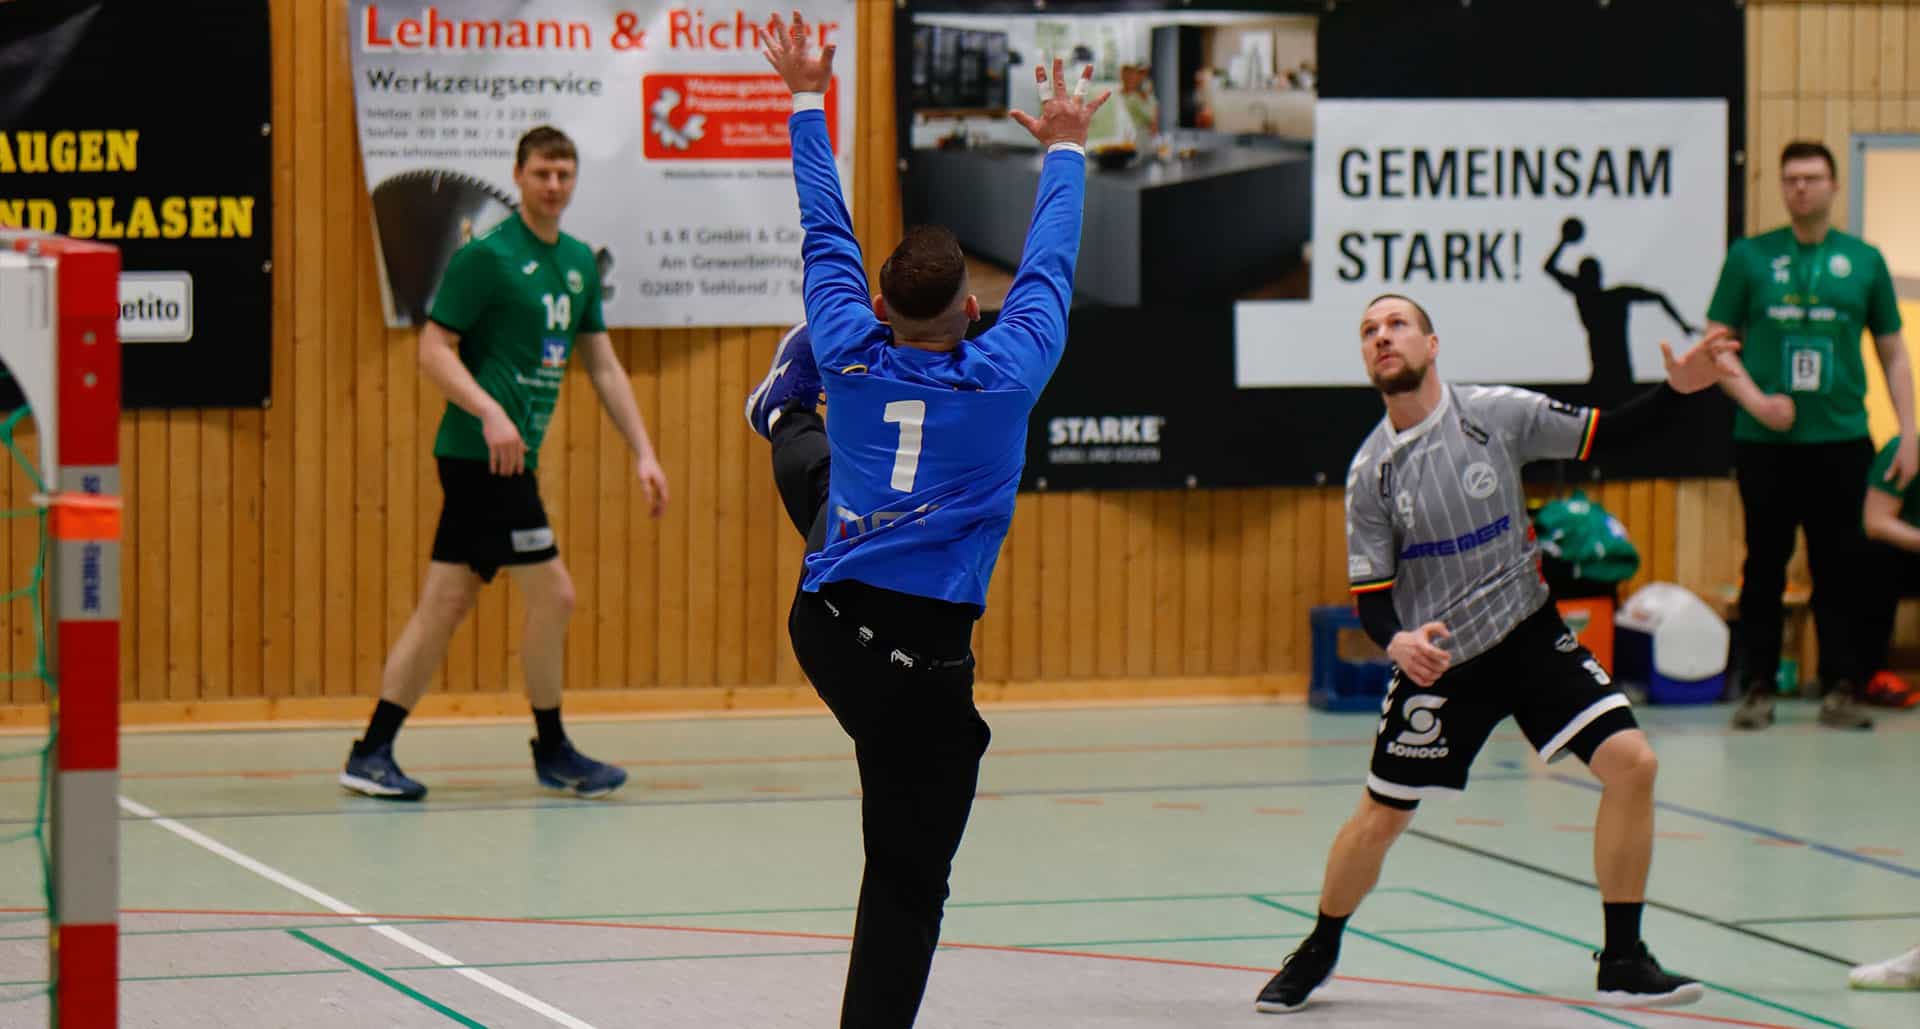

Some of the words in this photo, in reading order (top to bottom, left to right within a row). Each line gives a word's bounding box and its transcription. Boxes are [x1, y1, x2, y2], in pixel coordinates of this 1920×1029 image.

[366, 5, 591, 49] Lehmann
[610, 11, 645, 50] &
[367, 68, 602, 100] Werkzeugservice
[1339, 147, 1672, 199] GEMEINSAM
[69, 196, 255, 239] BLASEN
[1338, 231, 1522, 282] STARK!
[117, 292, 180, 322] etito
[542, 293, 571, 331] 14
[883, 399, 926, 493] 1
[1049, 416, 1161, 445] STARKE
